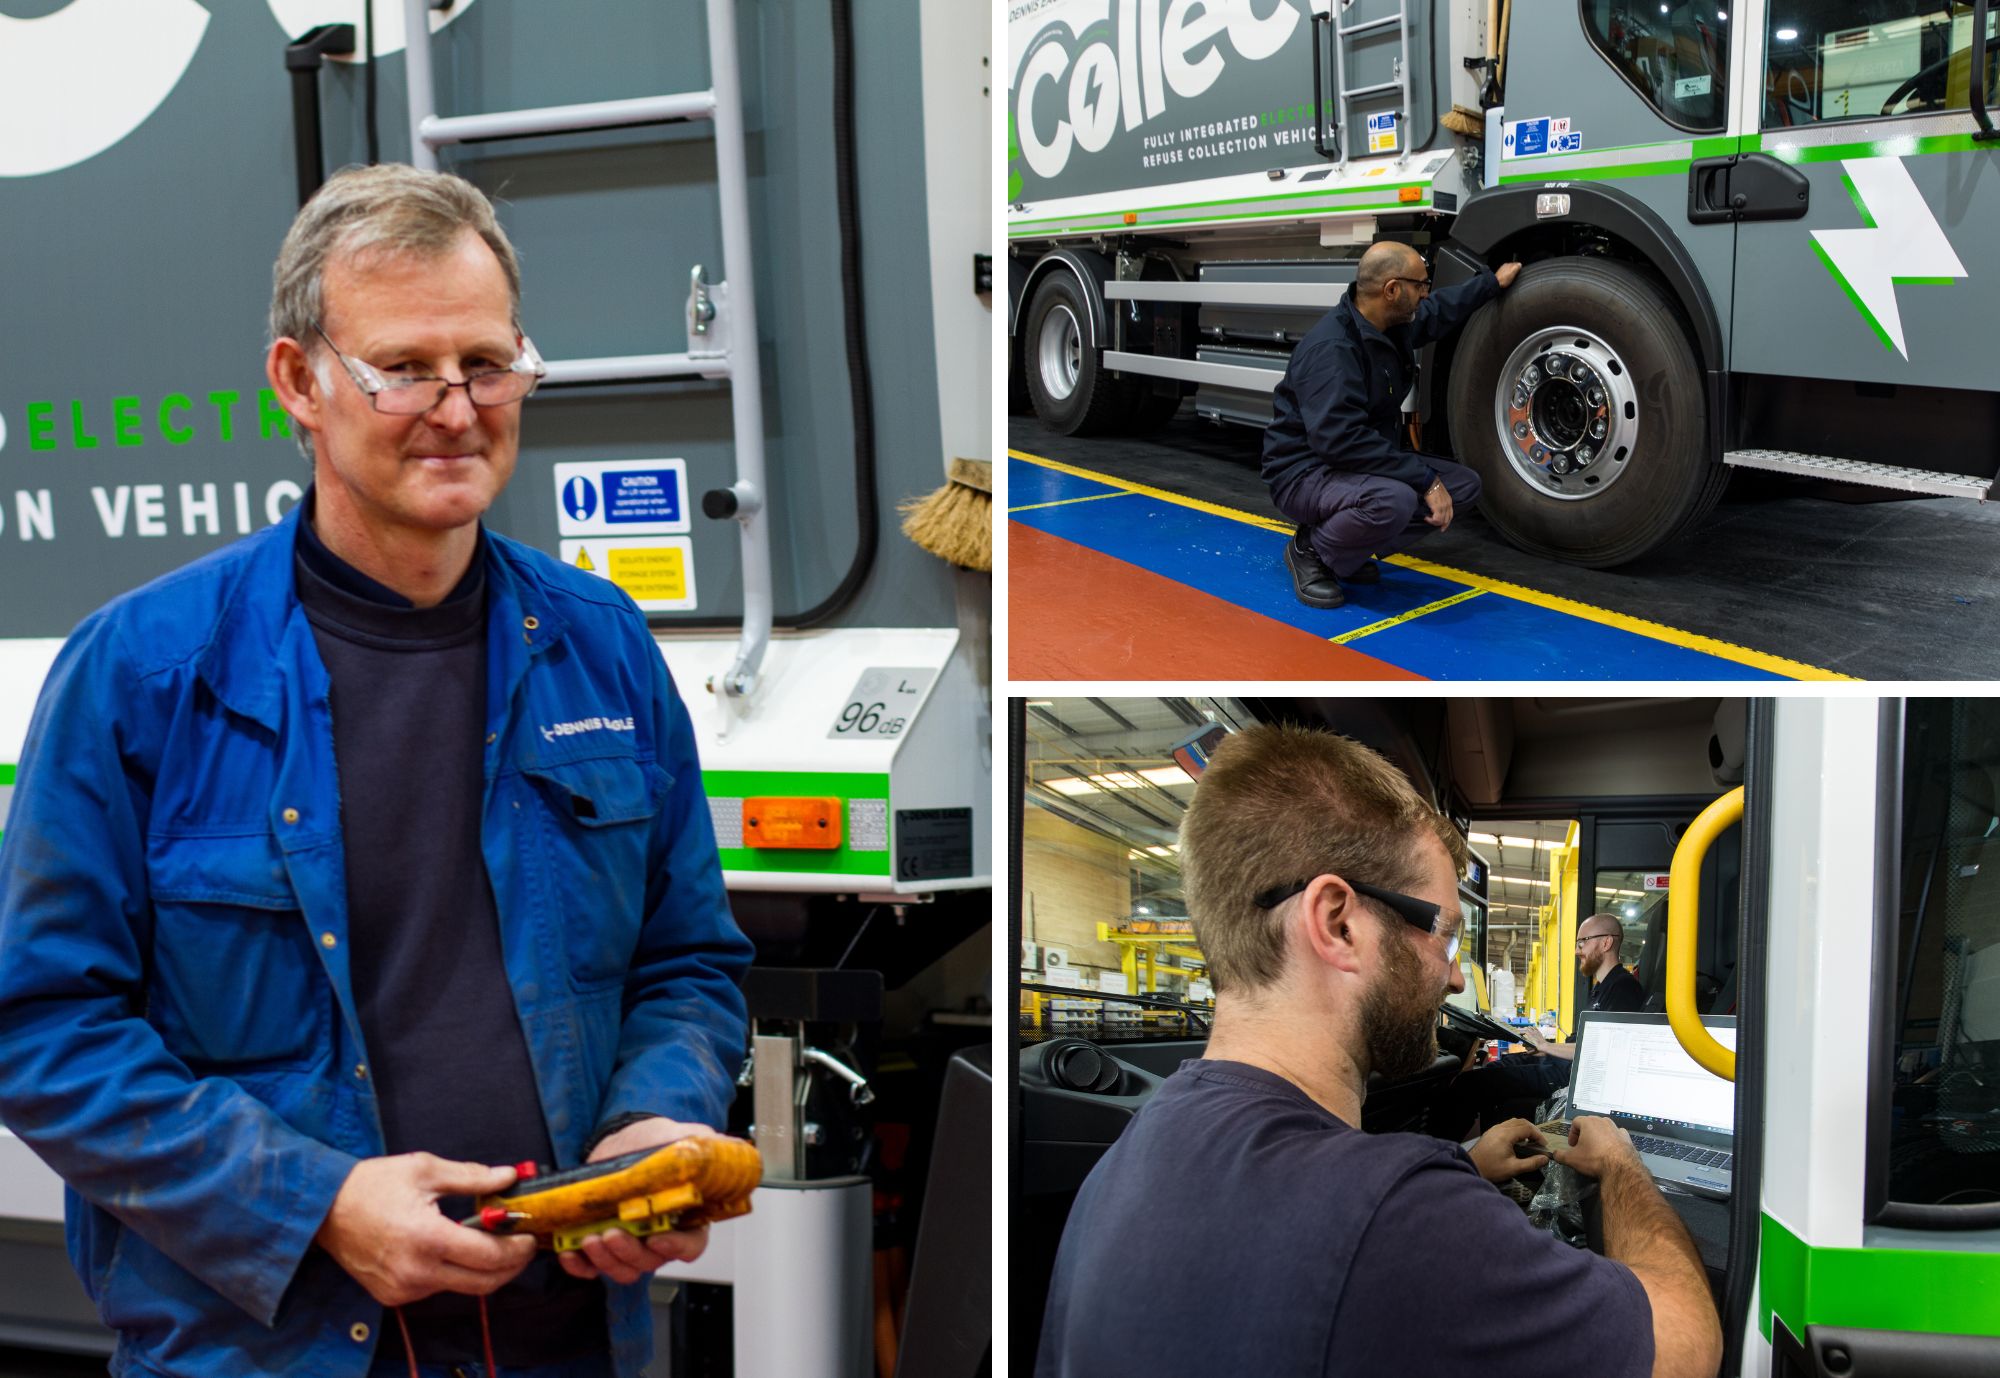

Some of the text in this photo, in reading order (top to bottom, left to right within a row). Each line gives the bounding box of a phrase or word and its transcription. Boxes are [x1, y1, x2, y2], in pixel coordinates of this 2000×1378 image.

[1143, 99, 1333, 149] FULLY INTEGRATED ELECTRC
[1143, 151, 1183, 168] REFUSE
[1188, 135, 1267, 161] COLLECTION
[27, 388, 293, 451] ELECTR
[91, 480, 303, 538] VEHIC
[553, 717, 602, 736] DENNIS
[836, 701, 906, 734] 96 dB
